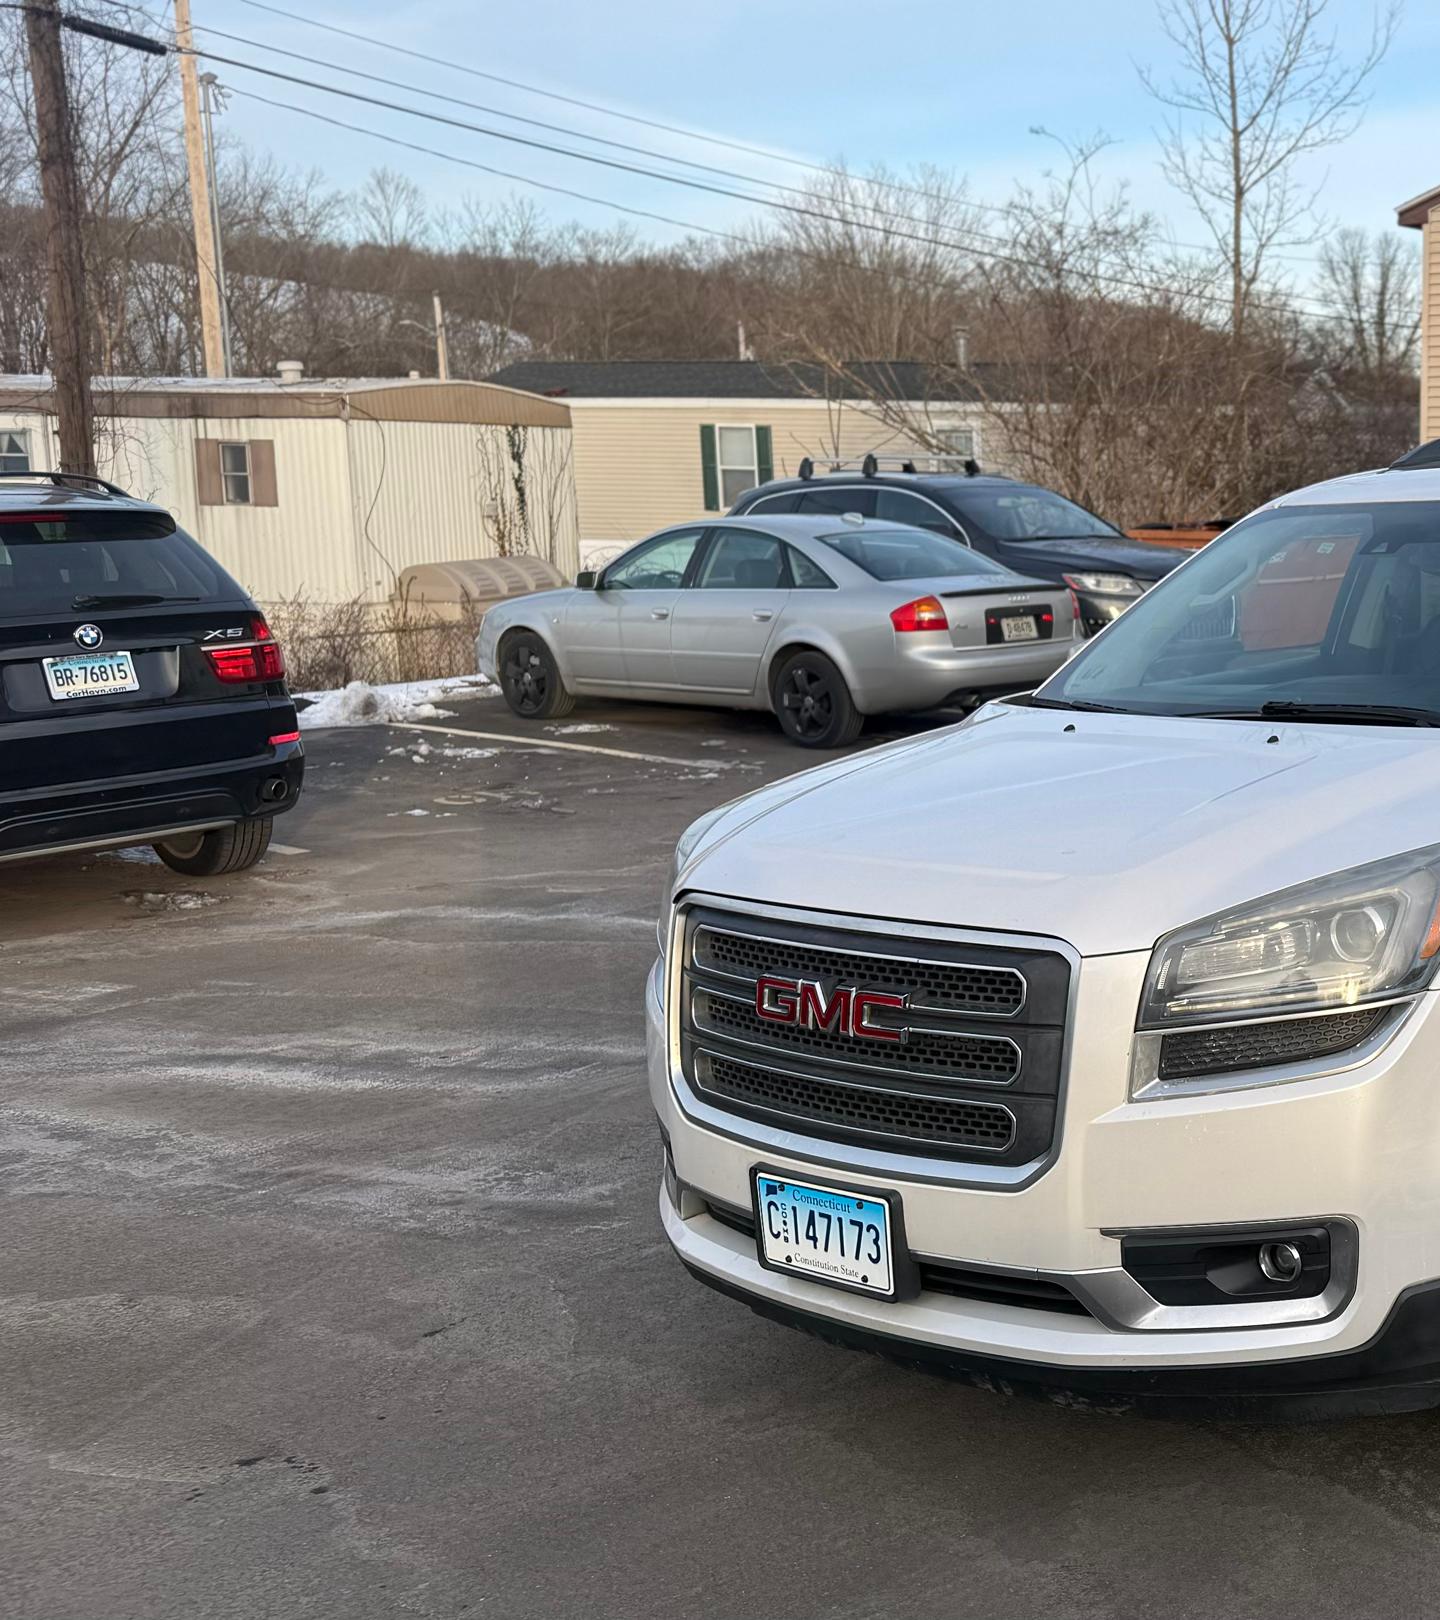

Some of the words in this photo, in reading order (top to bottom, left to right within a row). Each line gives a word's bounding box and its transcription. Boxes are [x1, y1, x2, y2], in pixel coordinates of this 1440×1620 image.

[203, 628, 244, 640] X5
[66, 686, 127, 698] CarHavn.com
[756, 973, 910, 1044] GMC
[792, 1190, 851, 1213] Connecticut
[794, 1252, 839, 1272] Constitution
[841, 1265, 859, 1278] State
